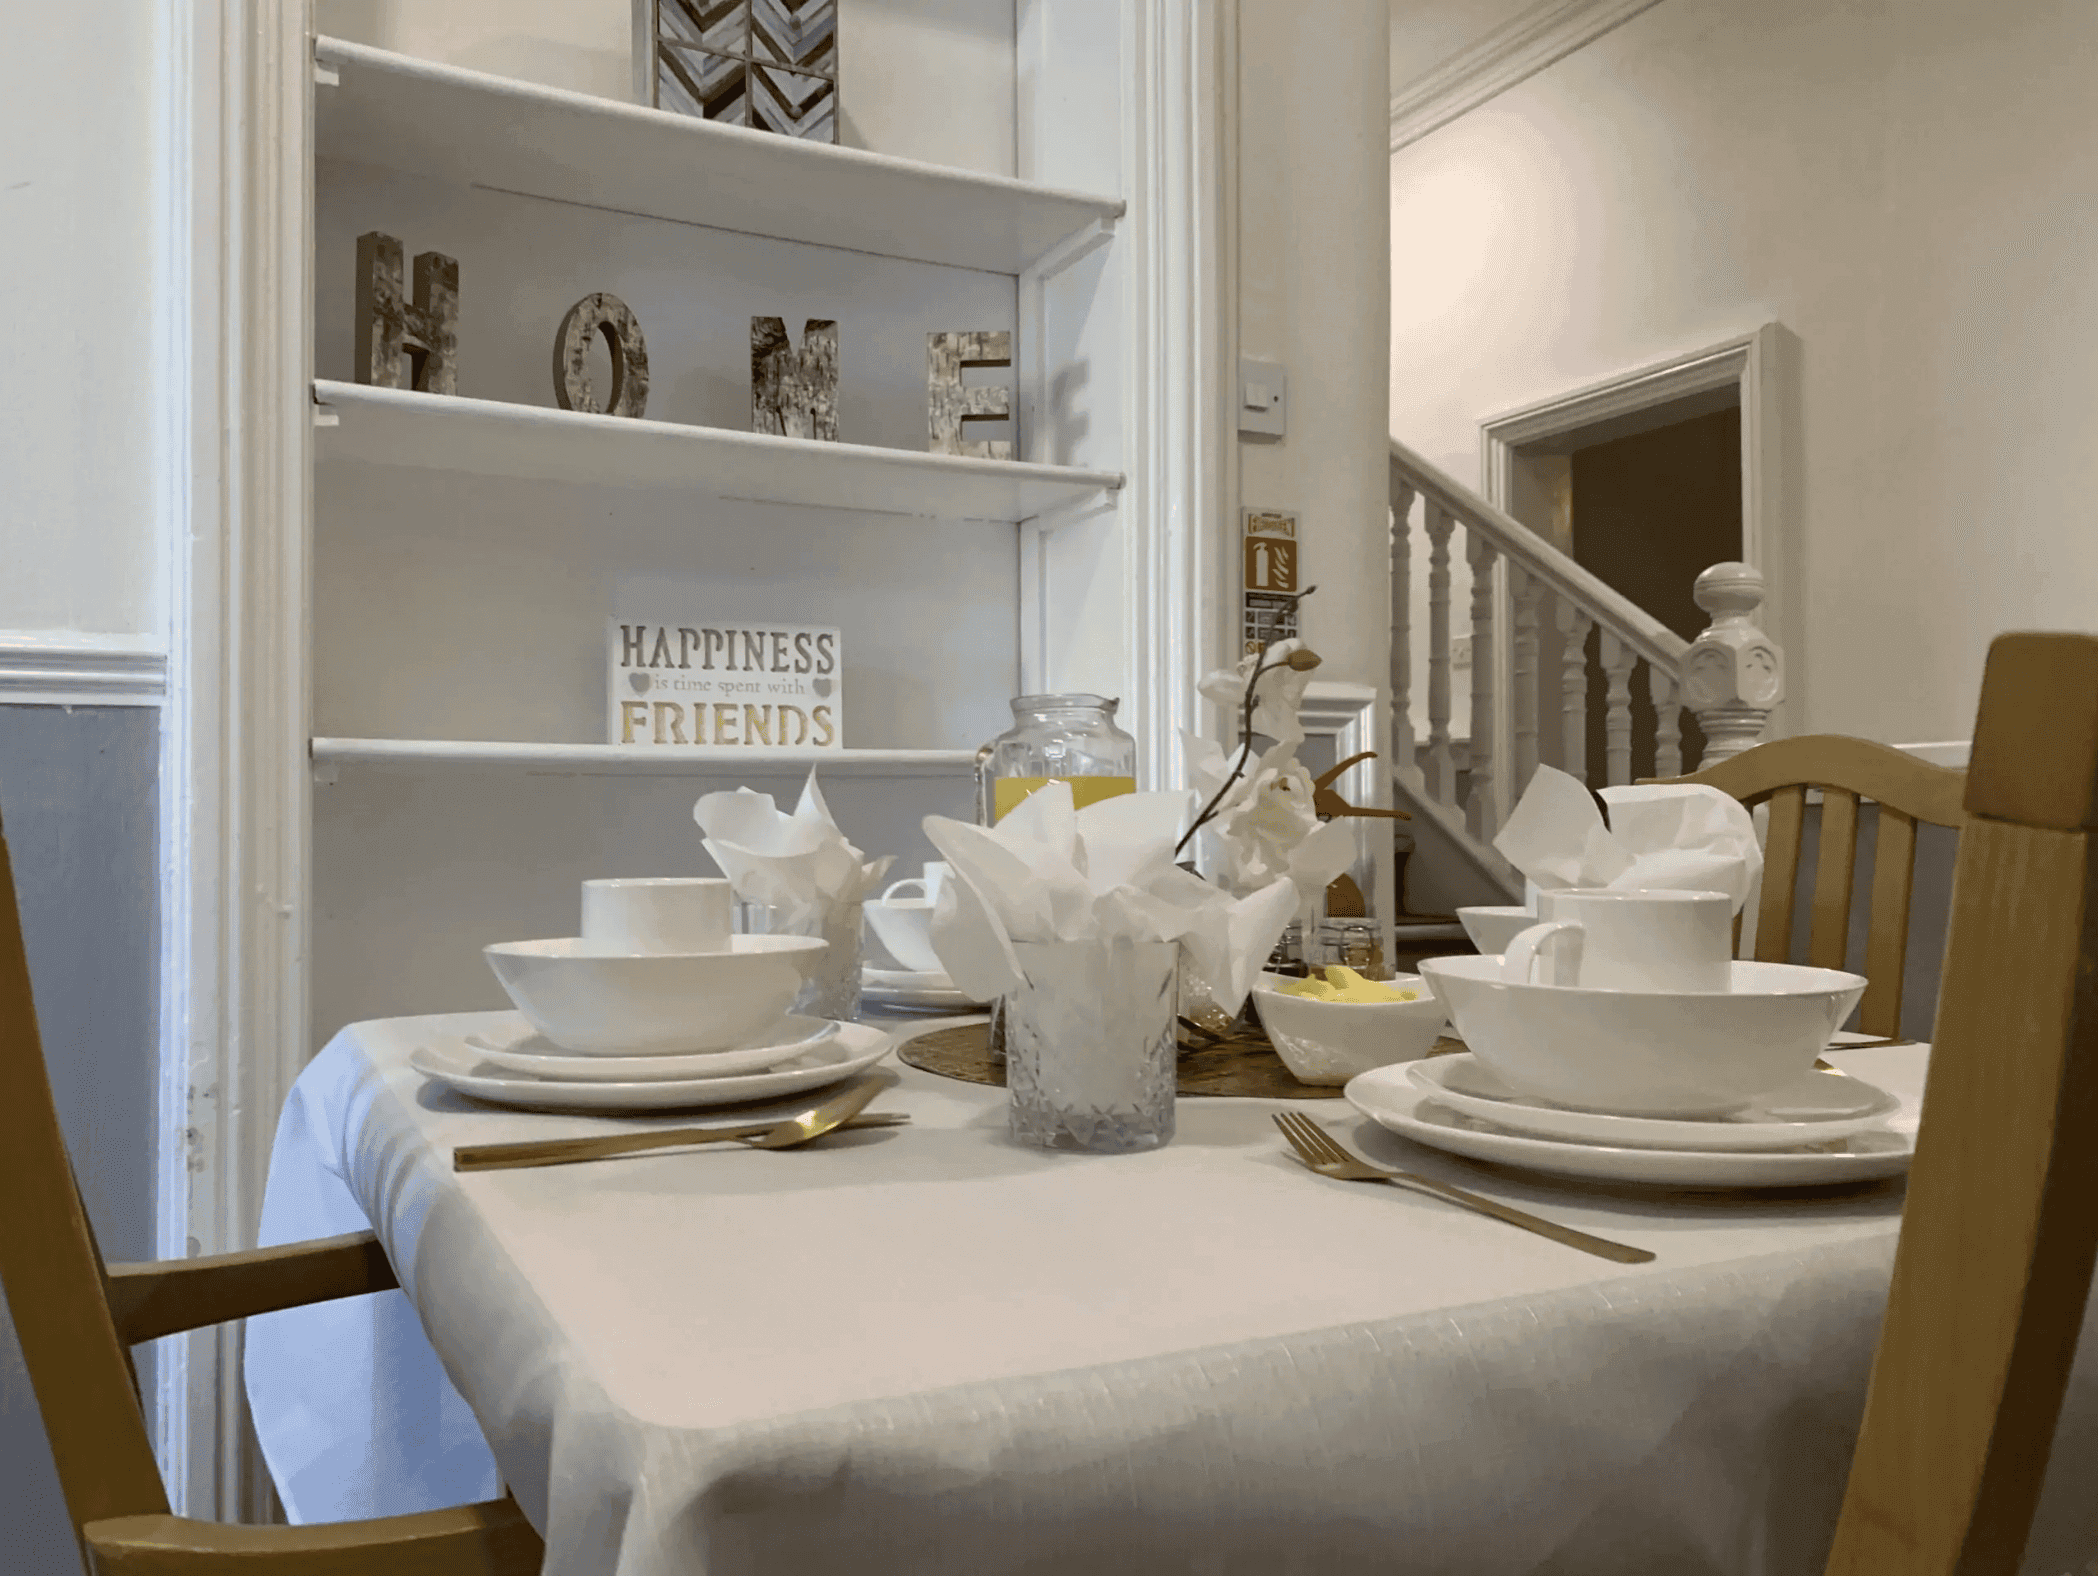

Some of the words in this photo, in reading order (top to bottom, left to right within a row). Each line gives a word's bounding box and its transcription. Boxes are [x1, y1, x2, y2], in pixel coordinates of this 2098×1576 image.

[356, 231, 1011, 460] HOME
[620, 625, 835, 675] HAPPINESS
[655, 674, 669, 690] is
[674, 674, 712, 692] time
[718, 679, 761, 697] spent
[767, 677, 806, 695] with
[621, 701, 835, 747] FRIENDS
